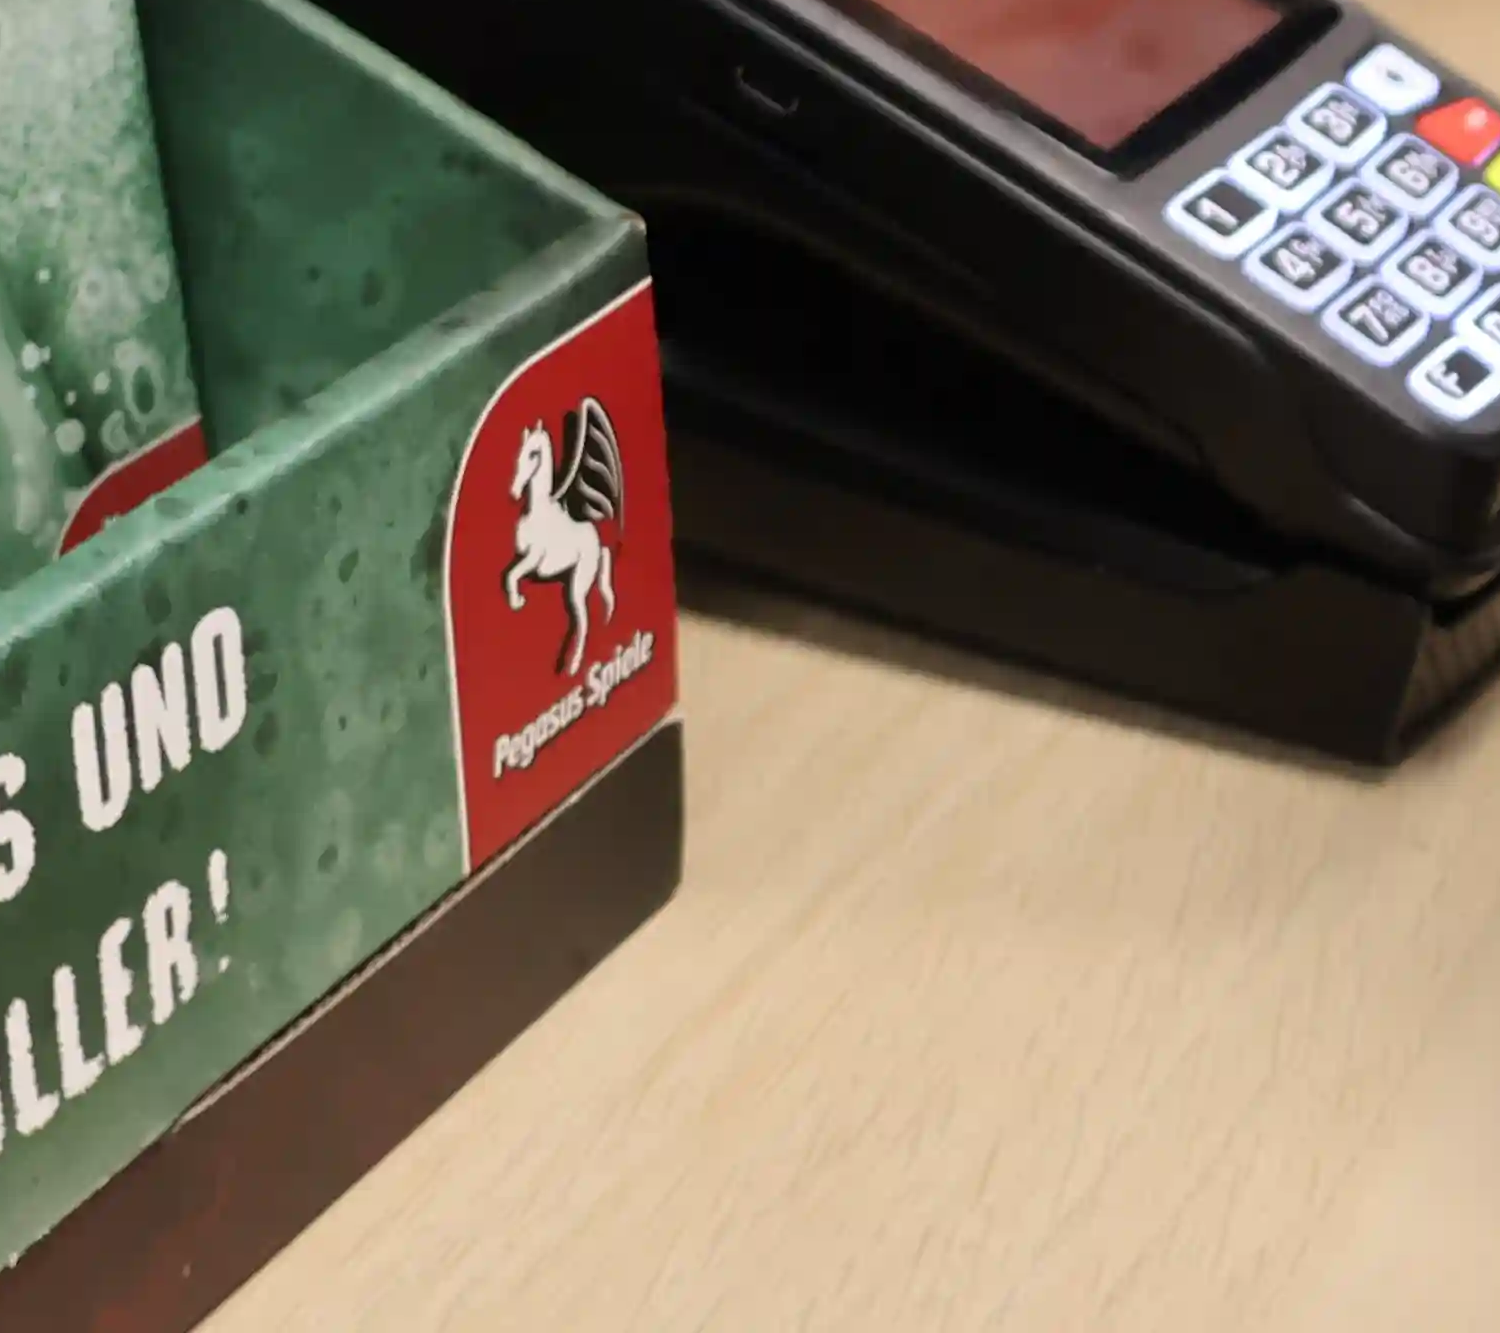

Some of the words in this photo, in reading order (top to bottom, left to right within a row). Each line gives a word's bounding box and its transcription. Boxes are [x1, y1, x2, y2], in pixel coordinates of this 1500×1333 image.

[72, 604, 249, 834] UND
[492, 682, 585, 779] Pegasus
[584, 629, 655, 708] Spiele
